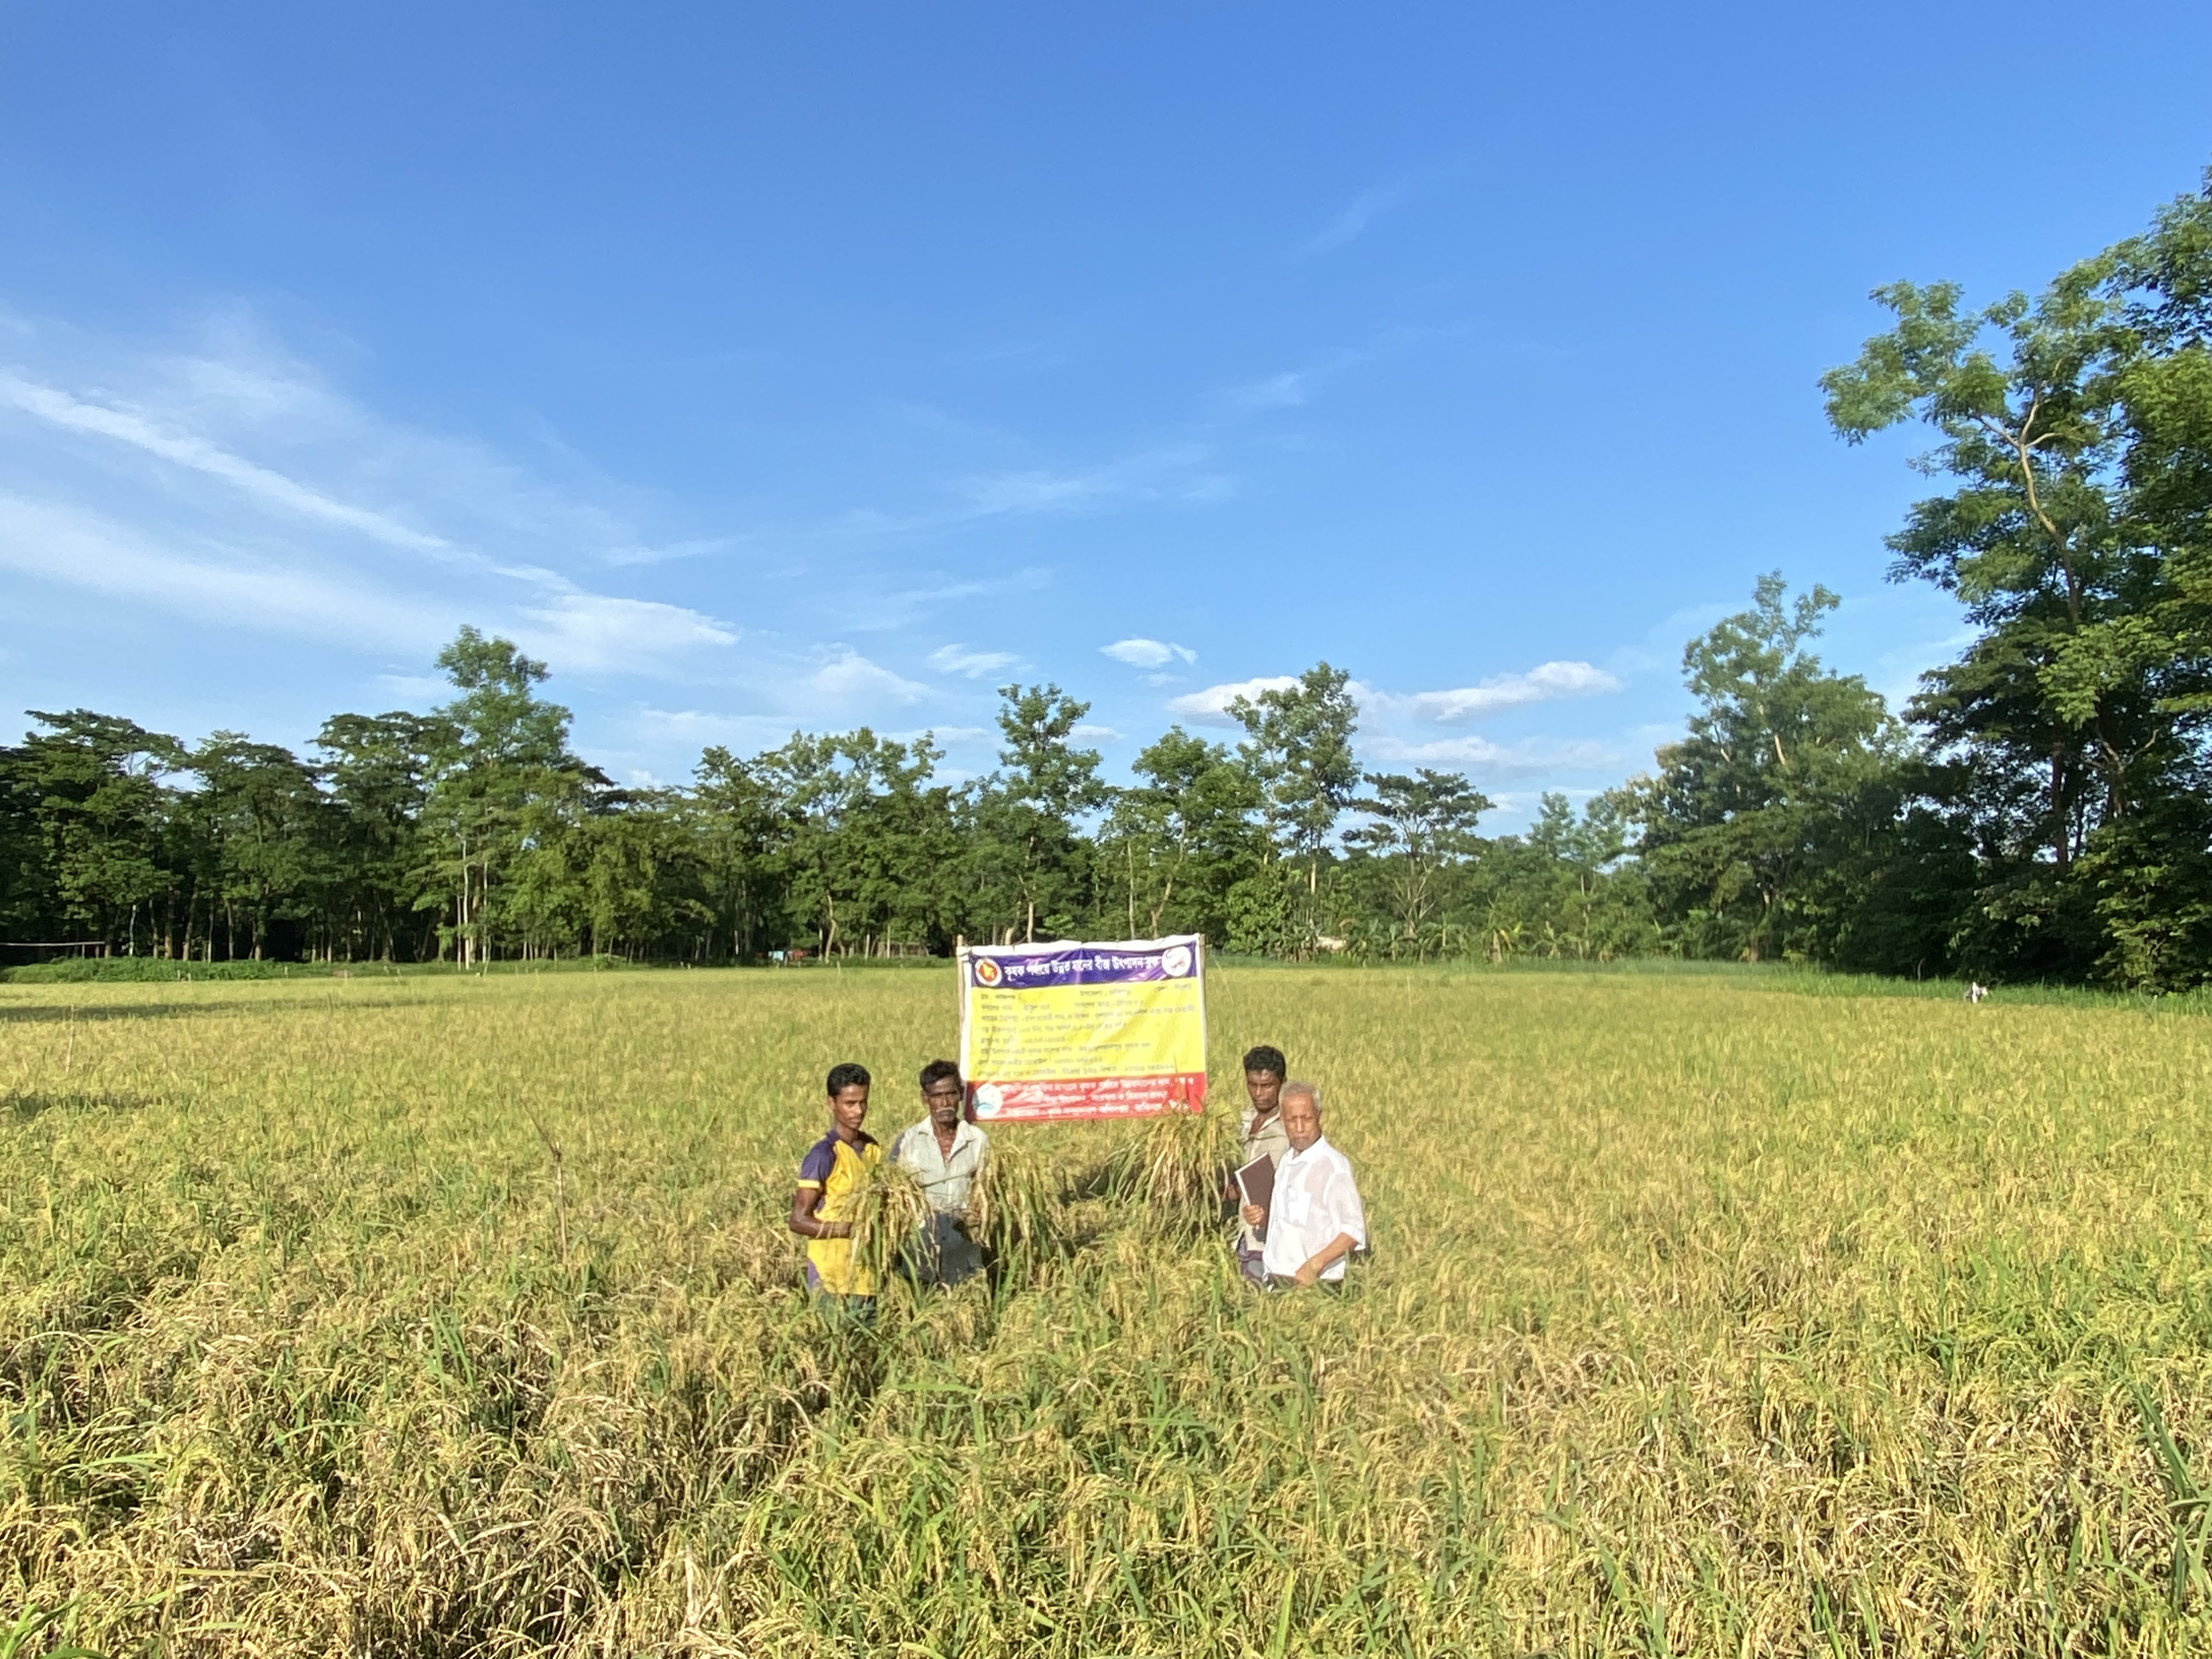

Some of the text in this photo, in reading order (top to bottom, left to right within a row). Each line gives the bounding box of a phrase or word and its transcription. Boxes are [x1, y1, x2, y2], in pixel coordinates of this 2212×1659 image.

[1004, 966, 1024, 981] কৃষক
[1051, 960, 1070, 974] উন্নত
[1072, 959, 1093, 972] মানের
[1094, 955, 1110, 970] বীজ
[1112, 956, 1143, 969] উৎপাদন
